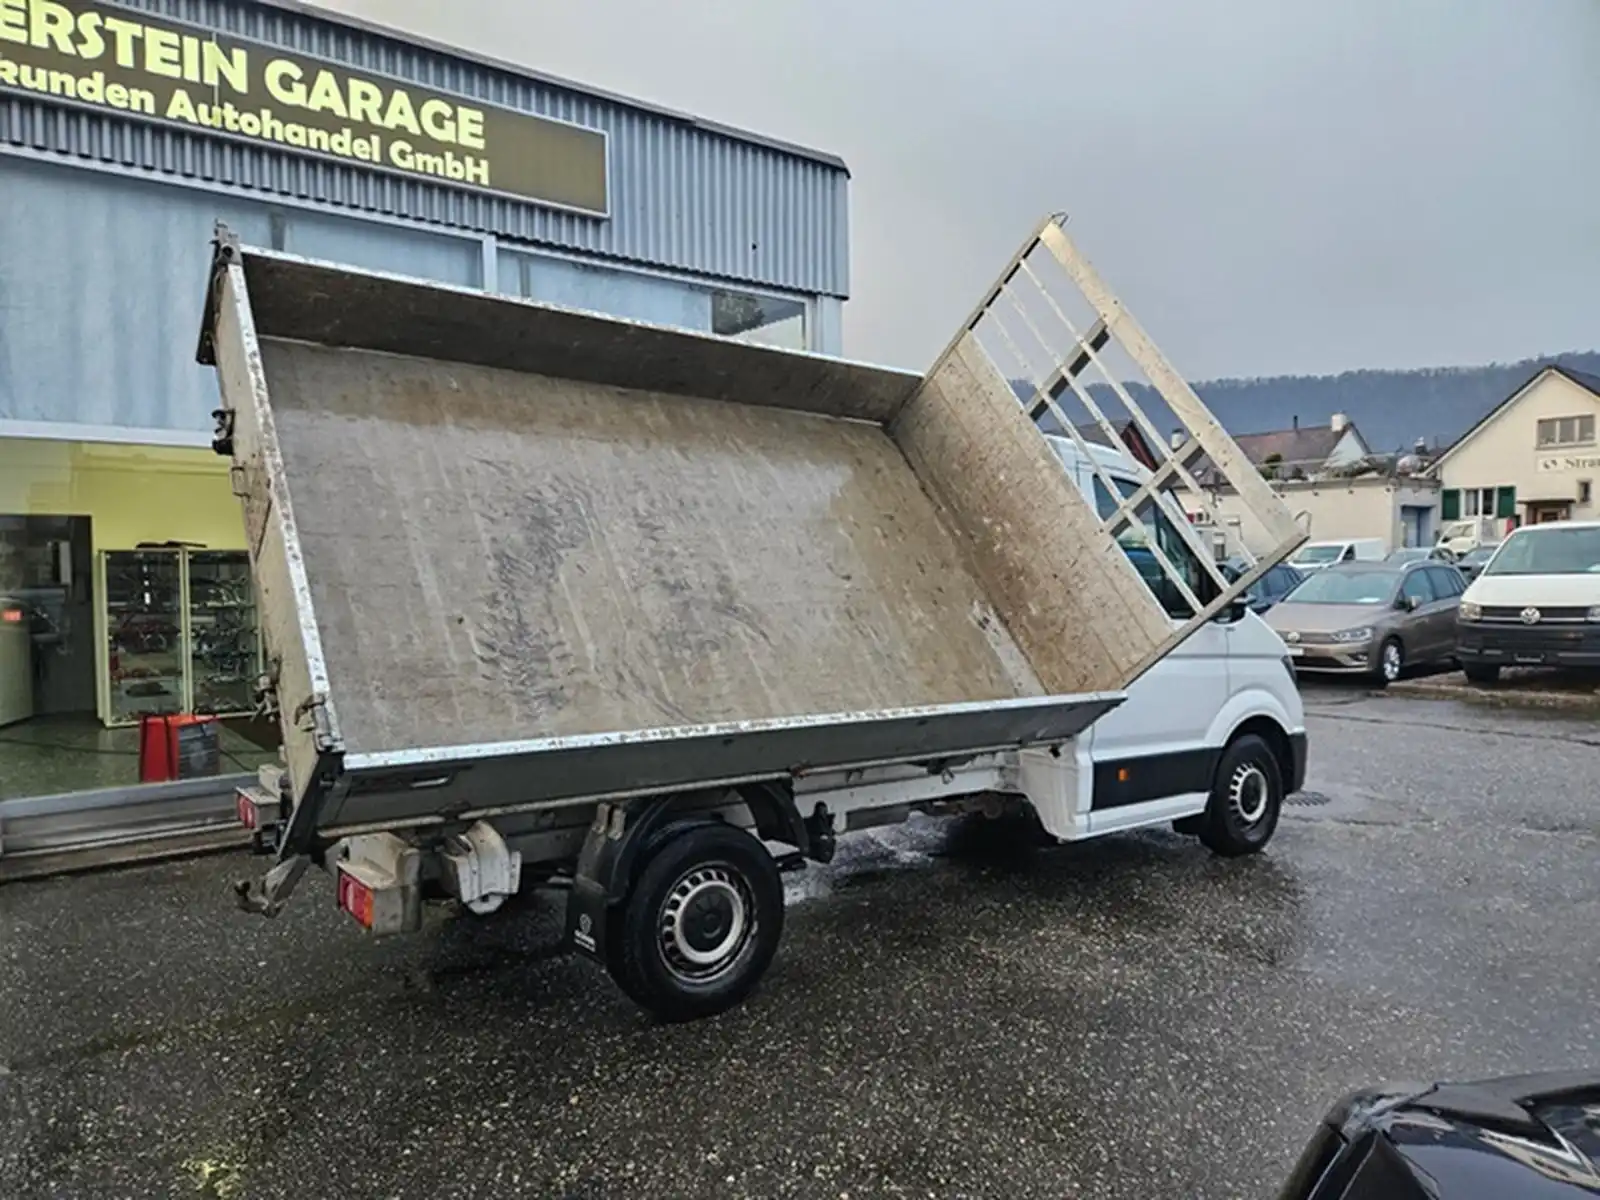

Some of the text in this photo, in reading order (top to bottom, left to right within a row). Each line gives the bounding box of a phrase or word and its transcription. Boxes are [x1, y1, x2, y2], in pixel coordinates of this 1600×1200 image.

[0, 0, 486, 150] ERSTEIN GARAGE
[165, 88, 381, 163] Autohandel
[388, 139, 490, 186] GmbH
